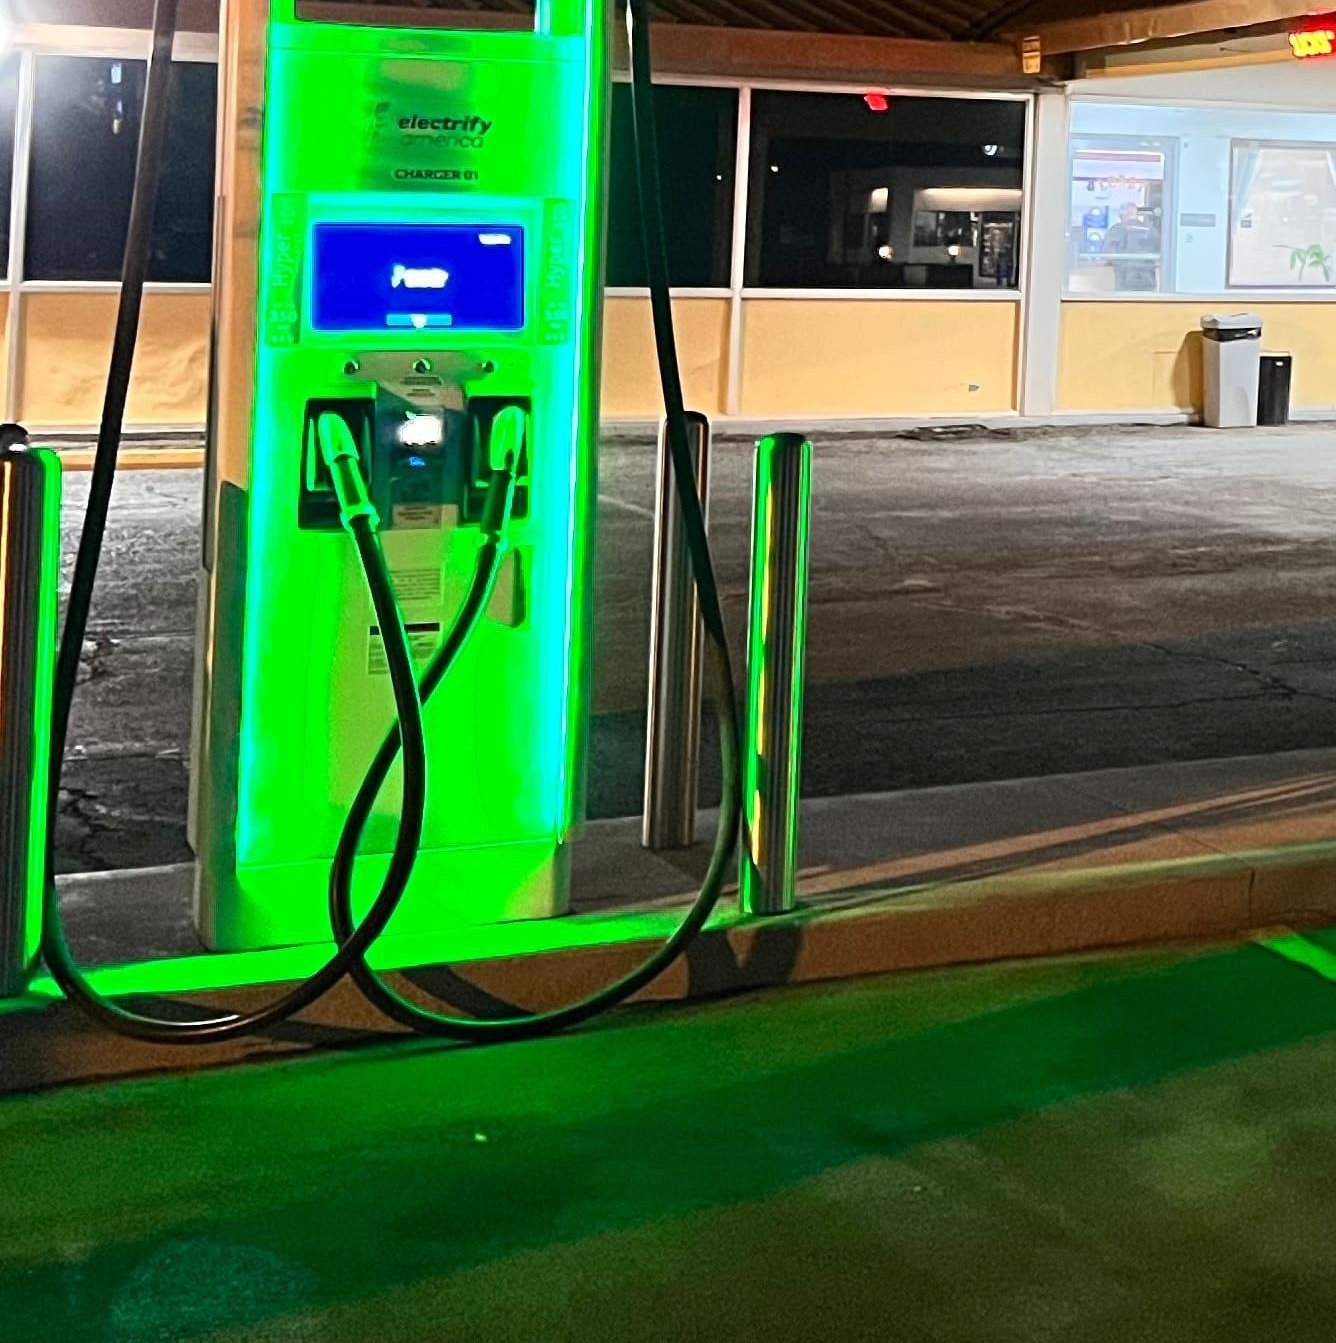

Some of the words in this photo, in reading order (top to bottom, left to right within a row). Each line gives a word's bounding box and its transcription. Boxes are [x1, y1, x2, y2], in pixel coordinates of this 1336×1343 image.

[398, 114, 493, 136] electrify
[394, 168, 461, 180] CHARGER
[463, 169, 479, 181] 01
